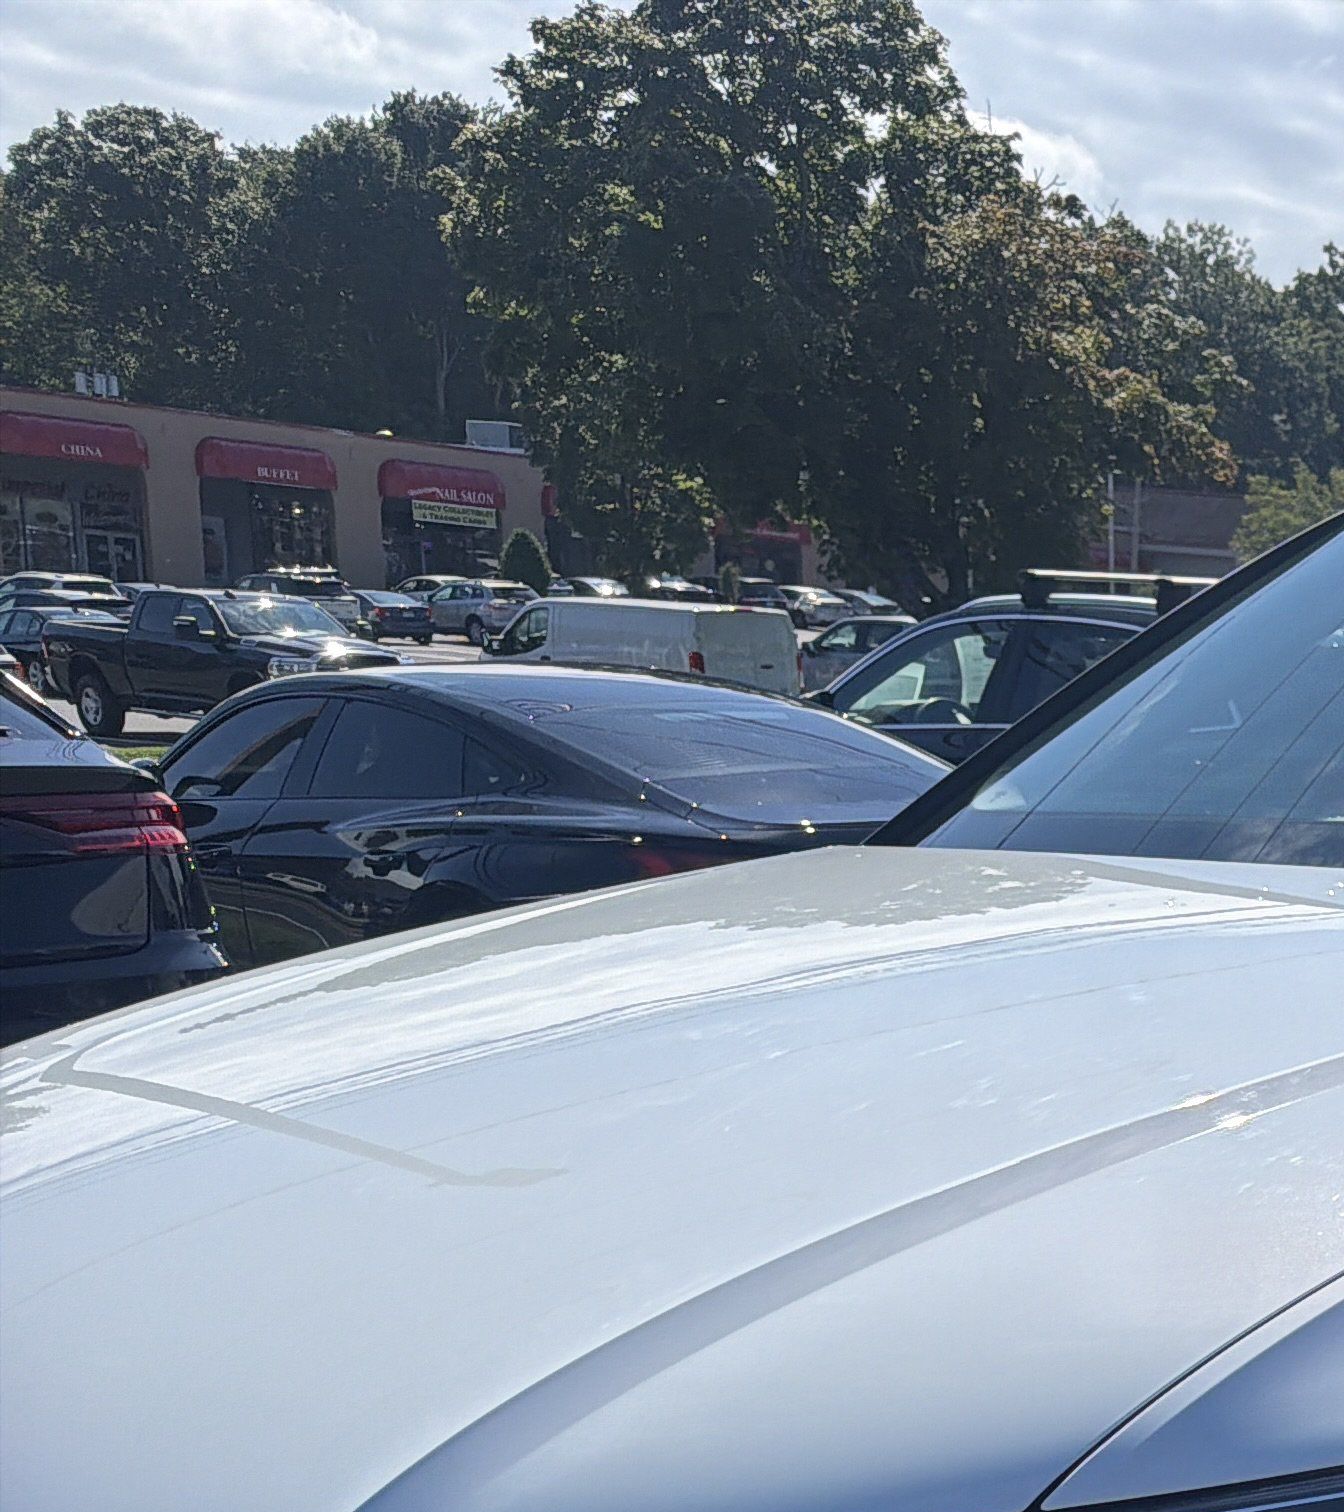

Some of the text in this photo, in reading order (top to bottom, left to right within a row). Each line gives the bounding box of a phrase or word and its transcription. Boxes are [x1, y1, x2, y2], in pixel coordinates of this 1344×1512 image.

[61, 443, 103, 458] CHINA
[257, 466, 299, 481] BUFFET
[437, 487, 460, 501] NAIL
[461, 490, 494, 504] SALON
